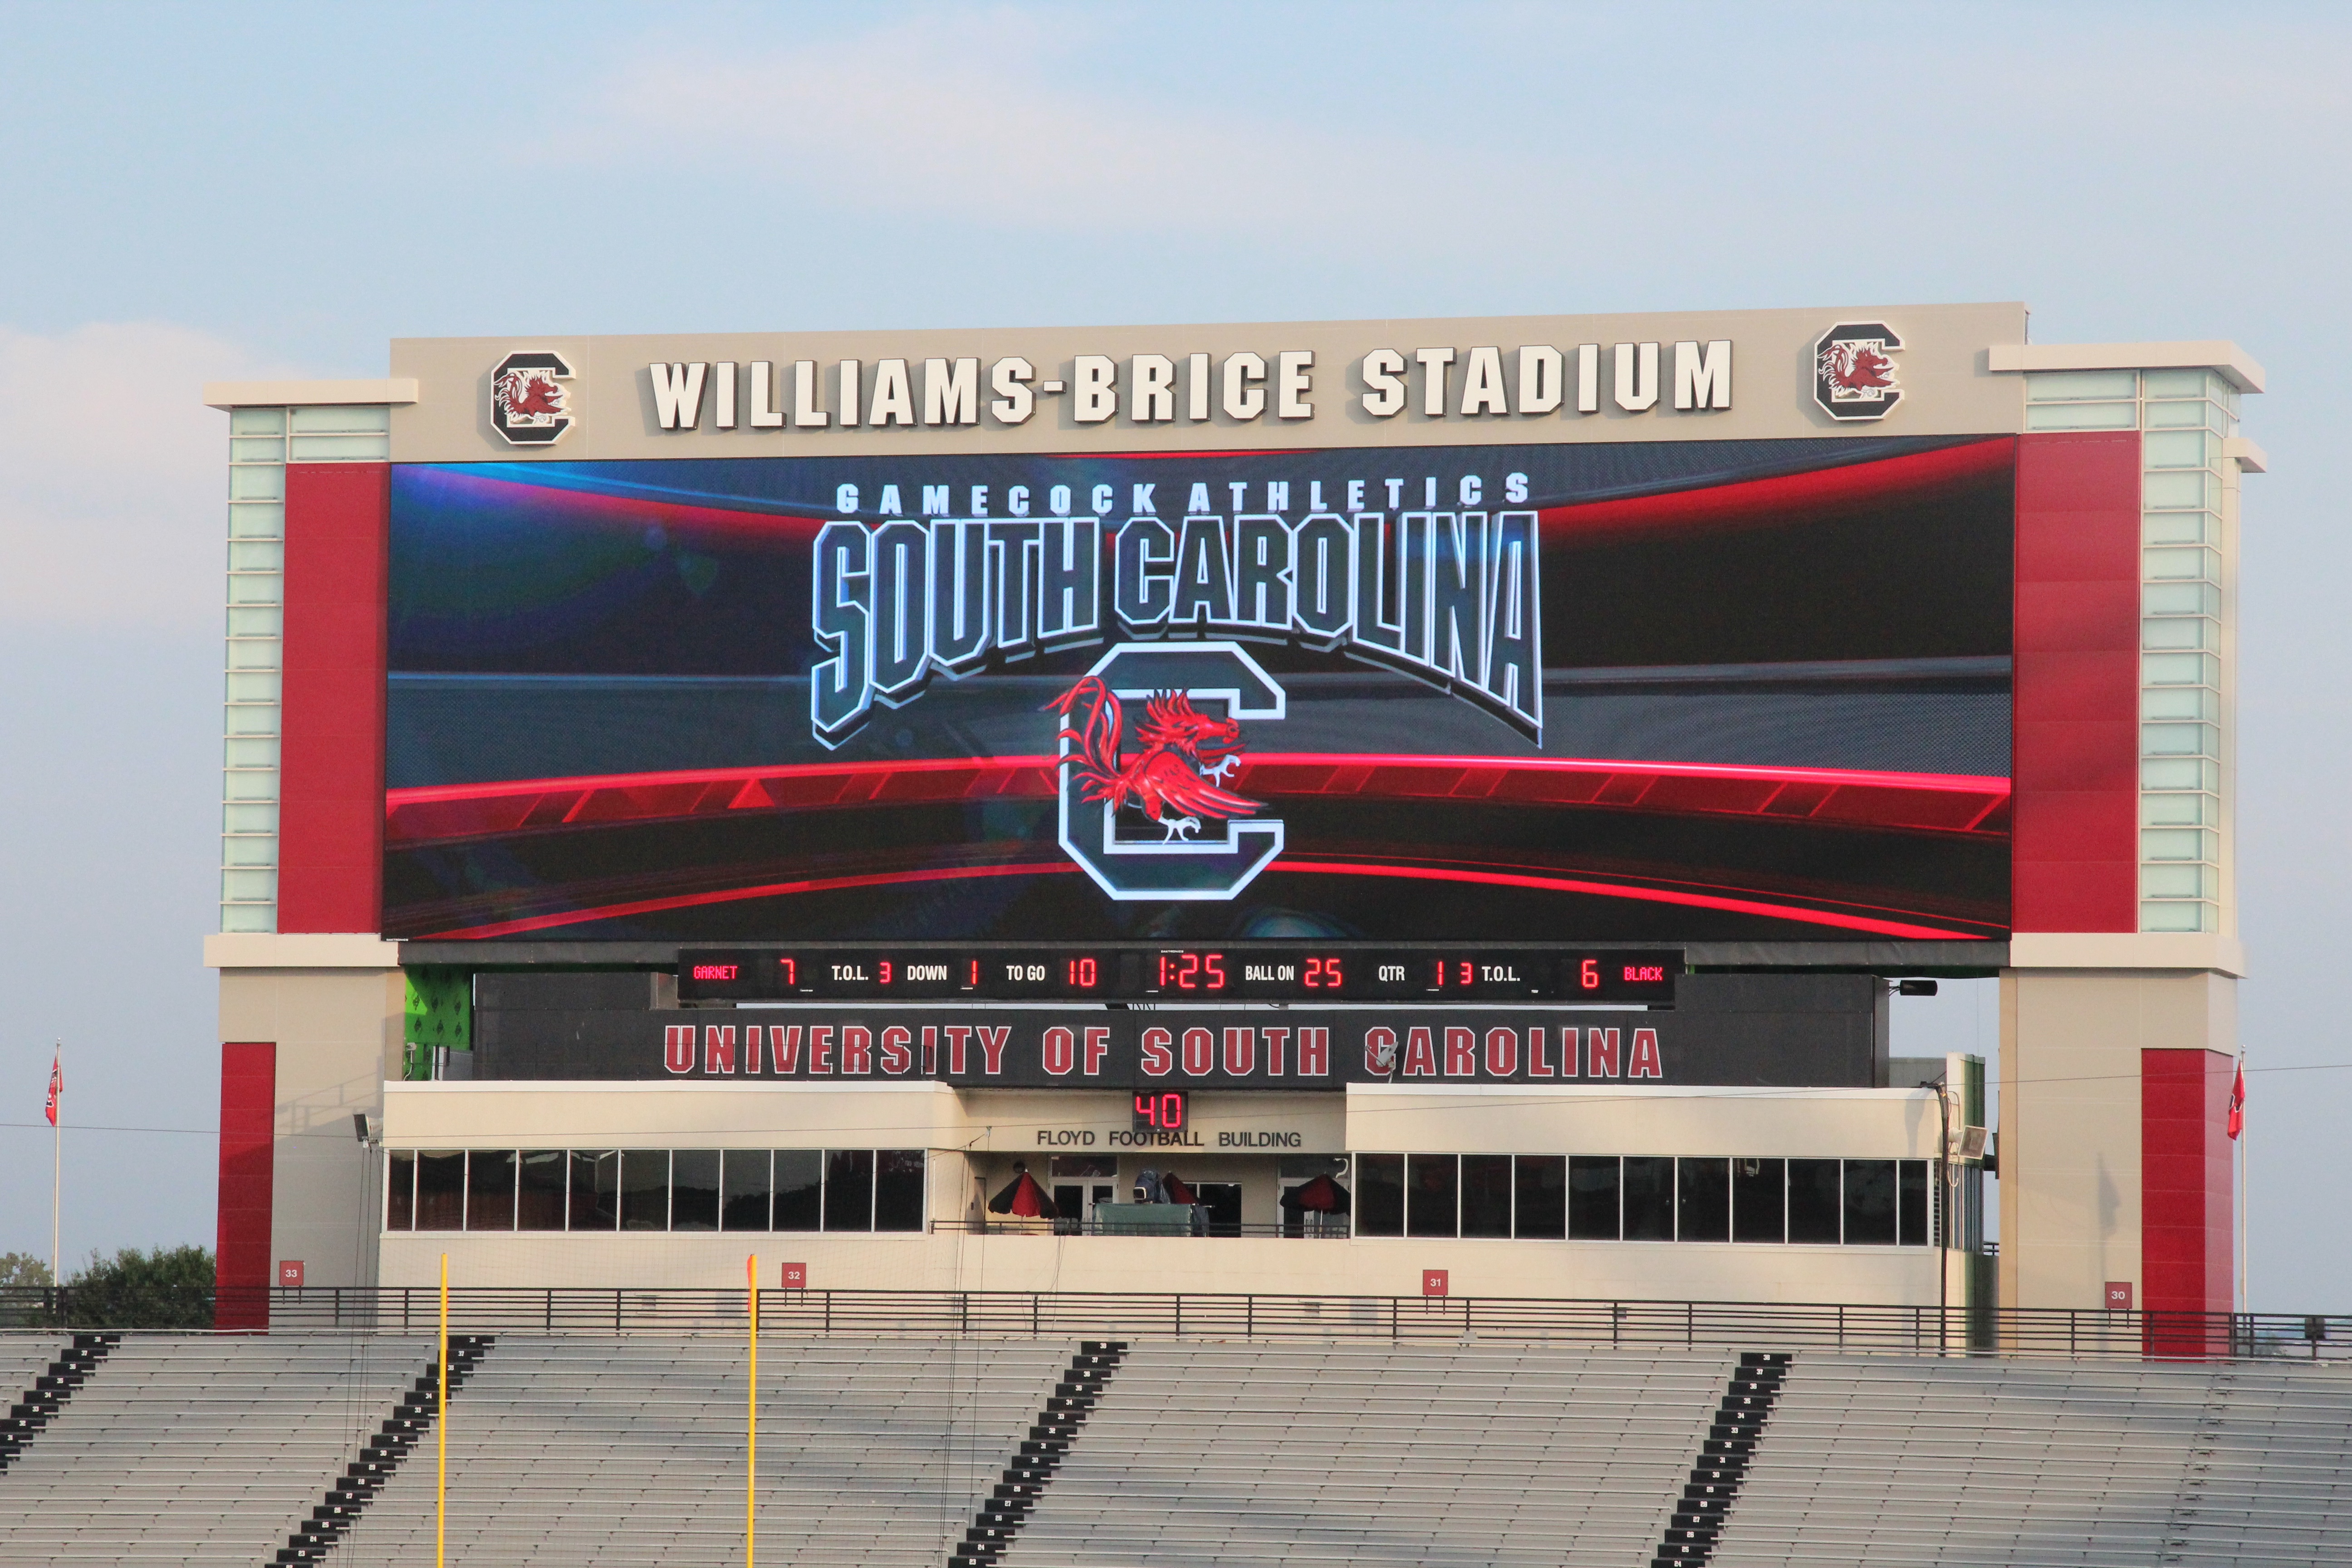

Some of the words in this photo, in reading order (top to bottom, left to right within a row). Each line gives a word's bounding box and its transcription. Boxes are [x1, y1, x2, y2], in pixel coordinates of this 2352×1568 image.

[649, 350, 1314, 430] WILLIAMS-BRICE
[1362, 339, 1733, 417] STADIUM
[836, 482, 1157, 516] GAMECOCK
[1188, 473, 1529, 515] ATHLETICS
[809, 516, 1104, 744] SOUTH
[1113, 510, 1544, 740] CAROLINA
[693, 965, 738, 980] GARNET
[780, 958, 795, 985] 7
[831, 965, 868, 981] T.O.L.
[879, 962, 892, 984] 3
[907, 965, 947, 981] DOWN
[971, 960, 978, 985] 1
[1006, 965, 1024, 981] TO
[1027, 965, 1045, 982] GO
[1069, 959, 1097, 986] 10
[1159, 954, 1225, 989] 1:25
[1245, 965, 1274, 981] BALL
[1277, 965, 1294, 981] ON
[1304, 958, 1343, 988] 25
[1378, 966, 1405, 982] QTR
[1437, 960, 1444, 985] 1
[1460, 962, 1474, 984] 3
[1482, 966, 1521, 982] T.O.L.
[1581, 960, 1599, 988] 6
[1624, 967, 1663, 981] BLACK
[664, 1024, 1011, 1075] UNIVERSITY
[1042, 1026, 1111, 1076] OF
[1141, 1026, 1330, 1077] SOUTH
[1365, 1026, 1662, 1078] CAROLINA
[1135, 1093, 1182, 1128] 40
[1037, 1130, 1095, 1145] FLOYD
[1109, 1131, 1205, 1147] FOOTBALL
[1219, 1132, 1301, 1147] BUILDING
[285, 1269, 298, 1278] 33
[788, 1271, 800, 1280] 32
[1430, 1278, 1441, 1287] 31
[2111, 1291, 2126, 1300] 30
